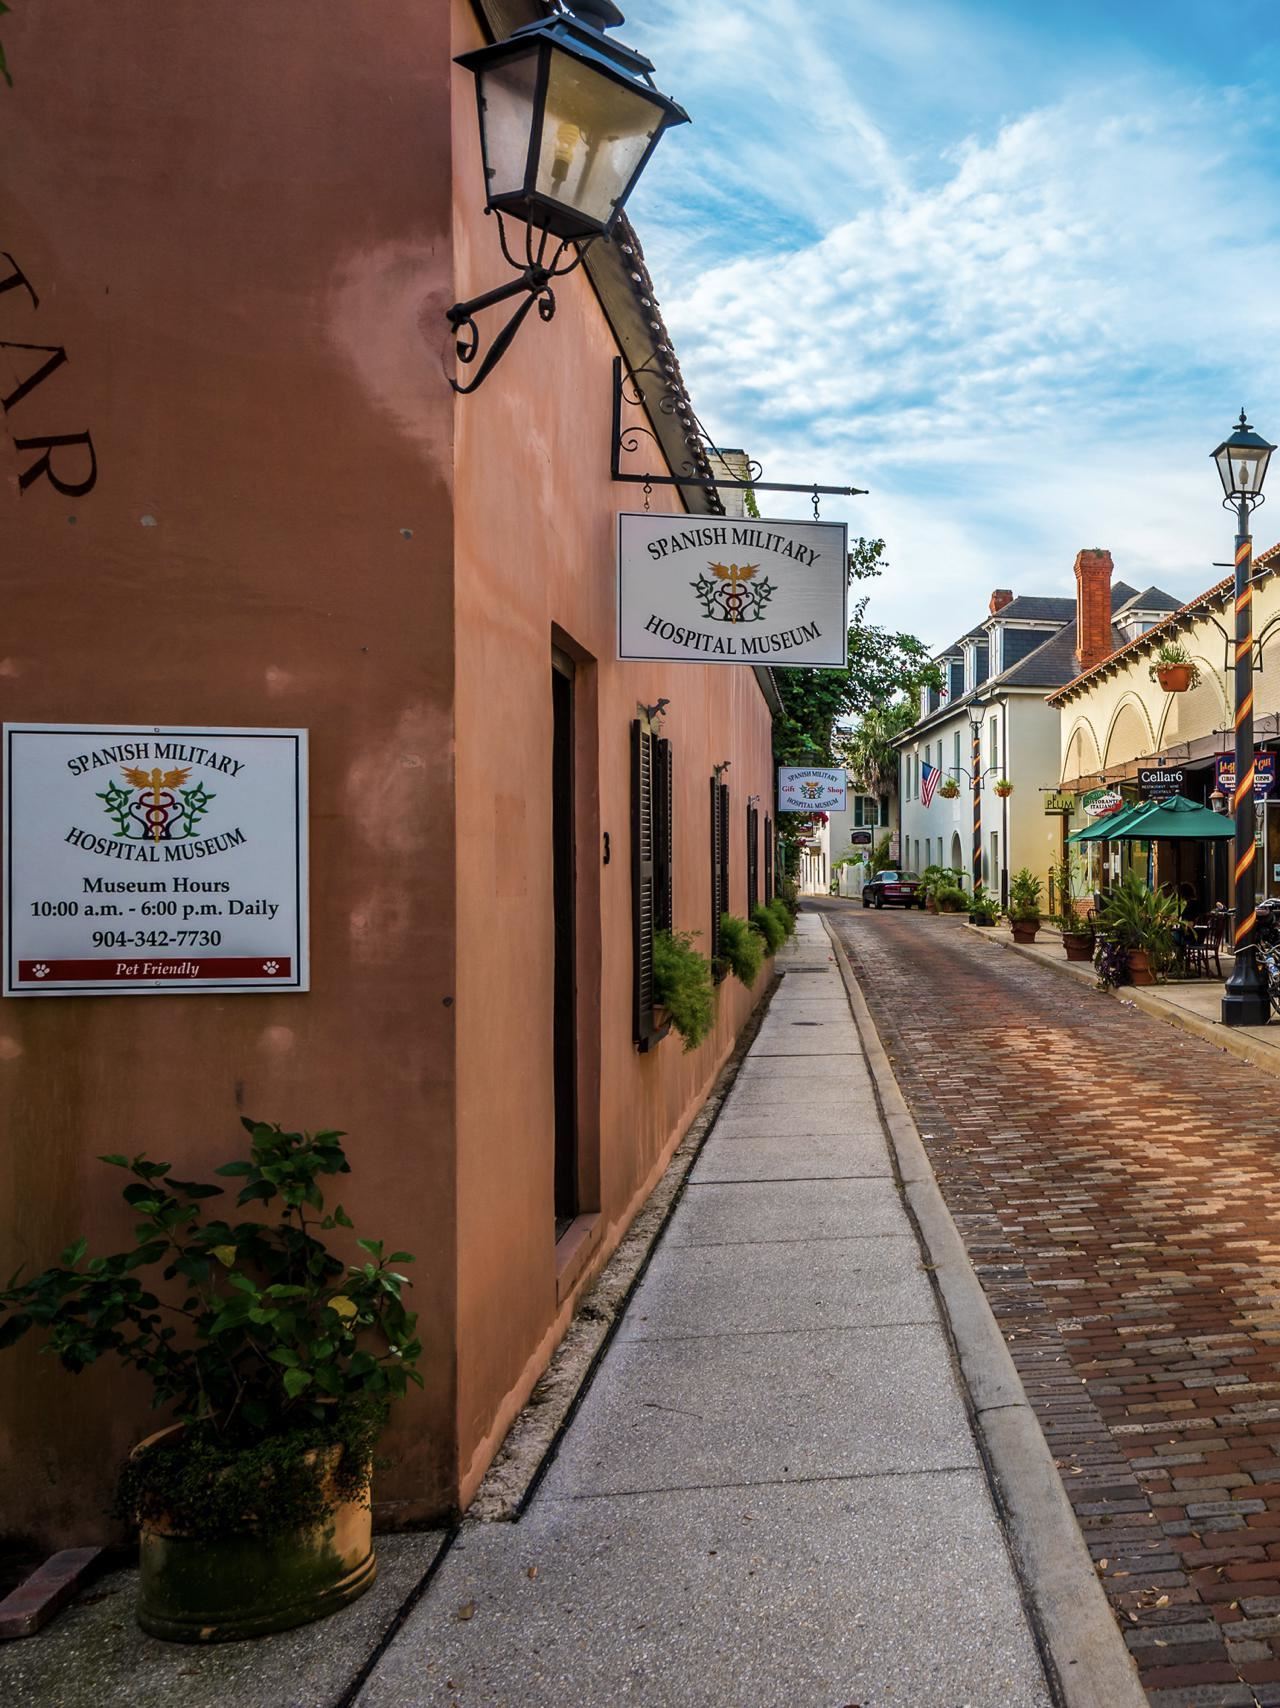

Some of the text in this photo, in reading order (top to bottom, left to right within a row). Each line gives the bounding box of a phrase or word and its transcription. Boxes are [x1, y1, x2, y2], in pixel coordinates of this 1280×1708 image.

[647, 528, 821, 568] SPANISH MILITARY
[643, 614, 823, 655] HOSPITAL MUSEUM
[67, 742, 245, 778] SPANISH MILITARY
[787, 771, 838, 782] SPANISH MILITARY
[1141, 771, 1183, 782] Cellar6
[827, 786, 844, 794] Shop
[787, 796, 839, 808] HOSPITAL MUSEUM
[1047, 800, 1073, 808] PLUM
[64, 826, 247, 862] HOSPITAL MUSEUM
[82, 877, 230, 893] Museum Hours
[30, 901, 78, 917] 10:00
[84, 903, 123, 916] a.m.
[141, 901, 177, 916] 6:00
[183, 903, 222, 920] p.m.
[228, 899, 279, 919] Daily
[92, 930, 221, 947] 904-342-7730
[115, 962, 200, 977] Pet Friendly
